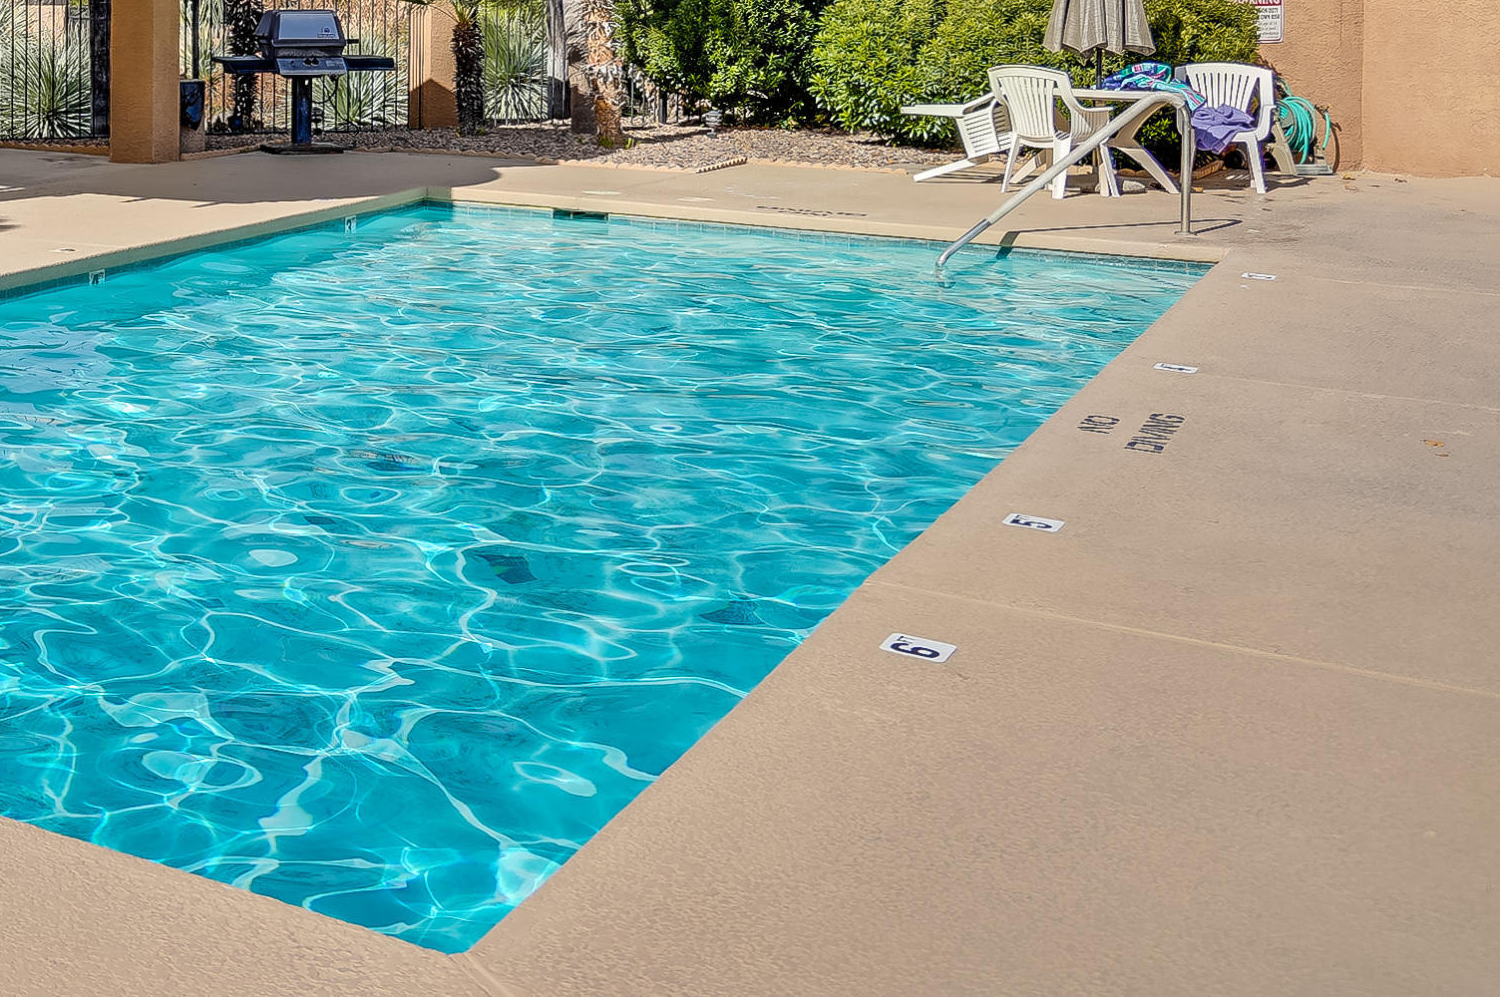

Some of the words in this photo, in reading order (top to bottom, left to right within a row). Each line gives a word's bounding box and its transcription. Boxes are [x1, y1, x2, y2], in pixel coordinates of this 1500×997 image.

[1077, 415, 1120, 435] NO
[1124, 413, 1185, 454] DIVING
[1009, 518, 1053, 529] 5
[890, 642, 941, 659] 6
